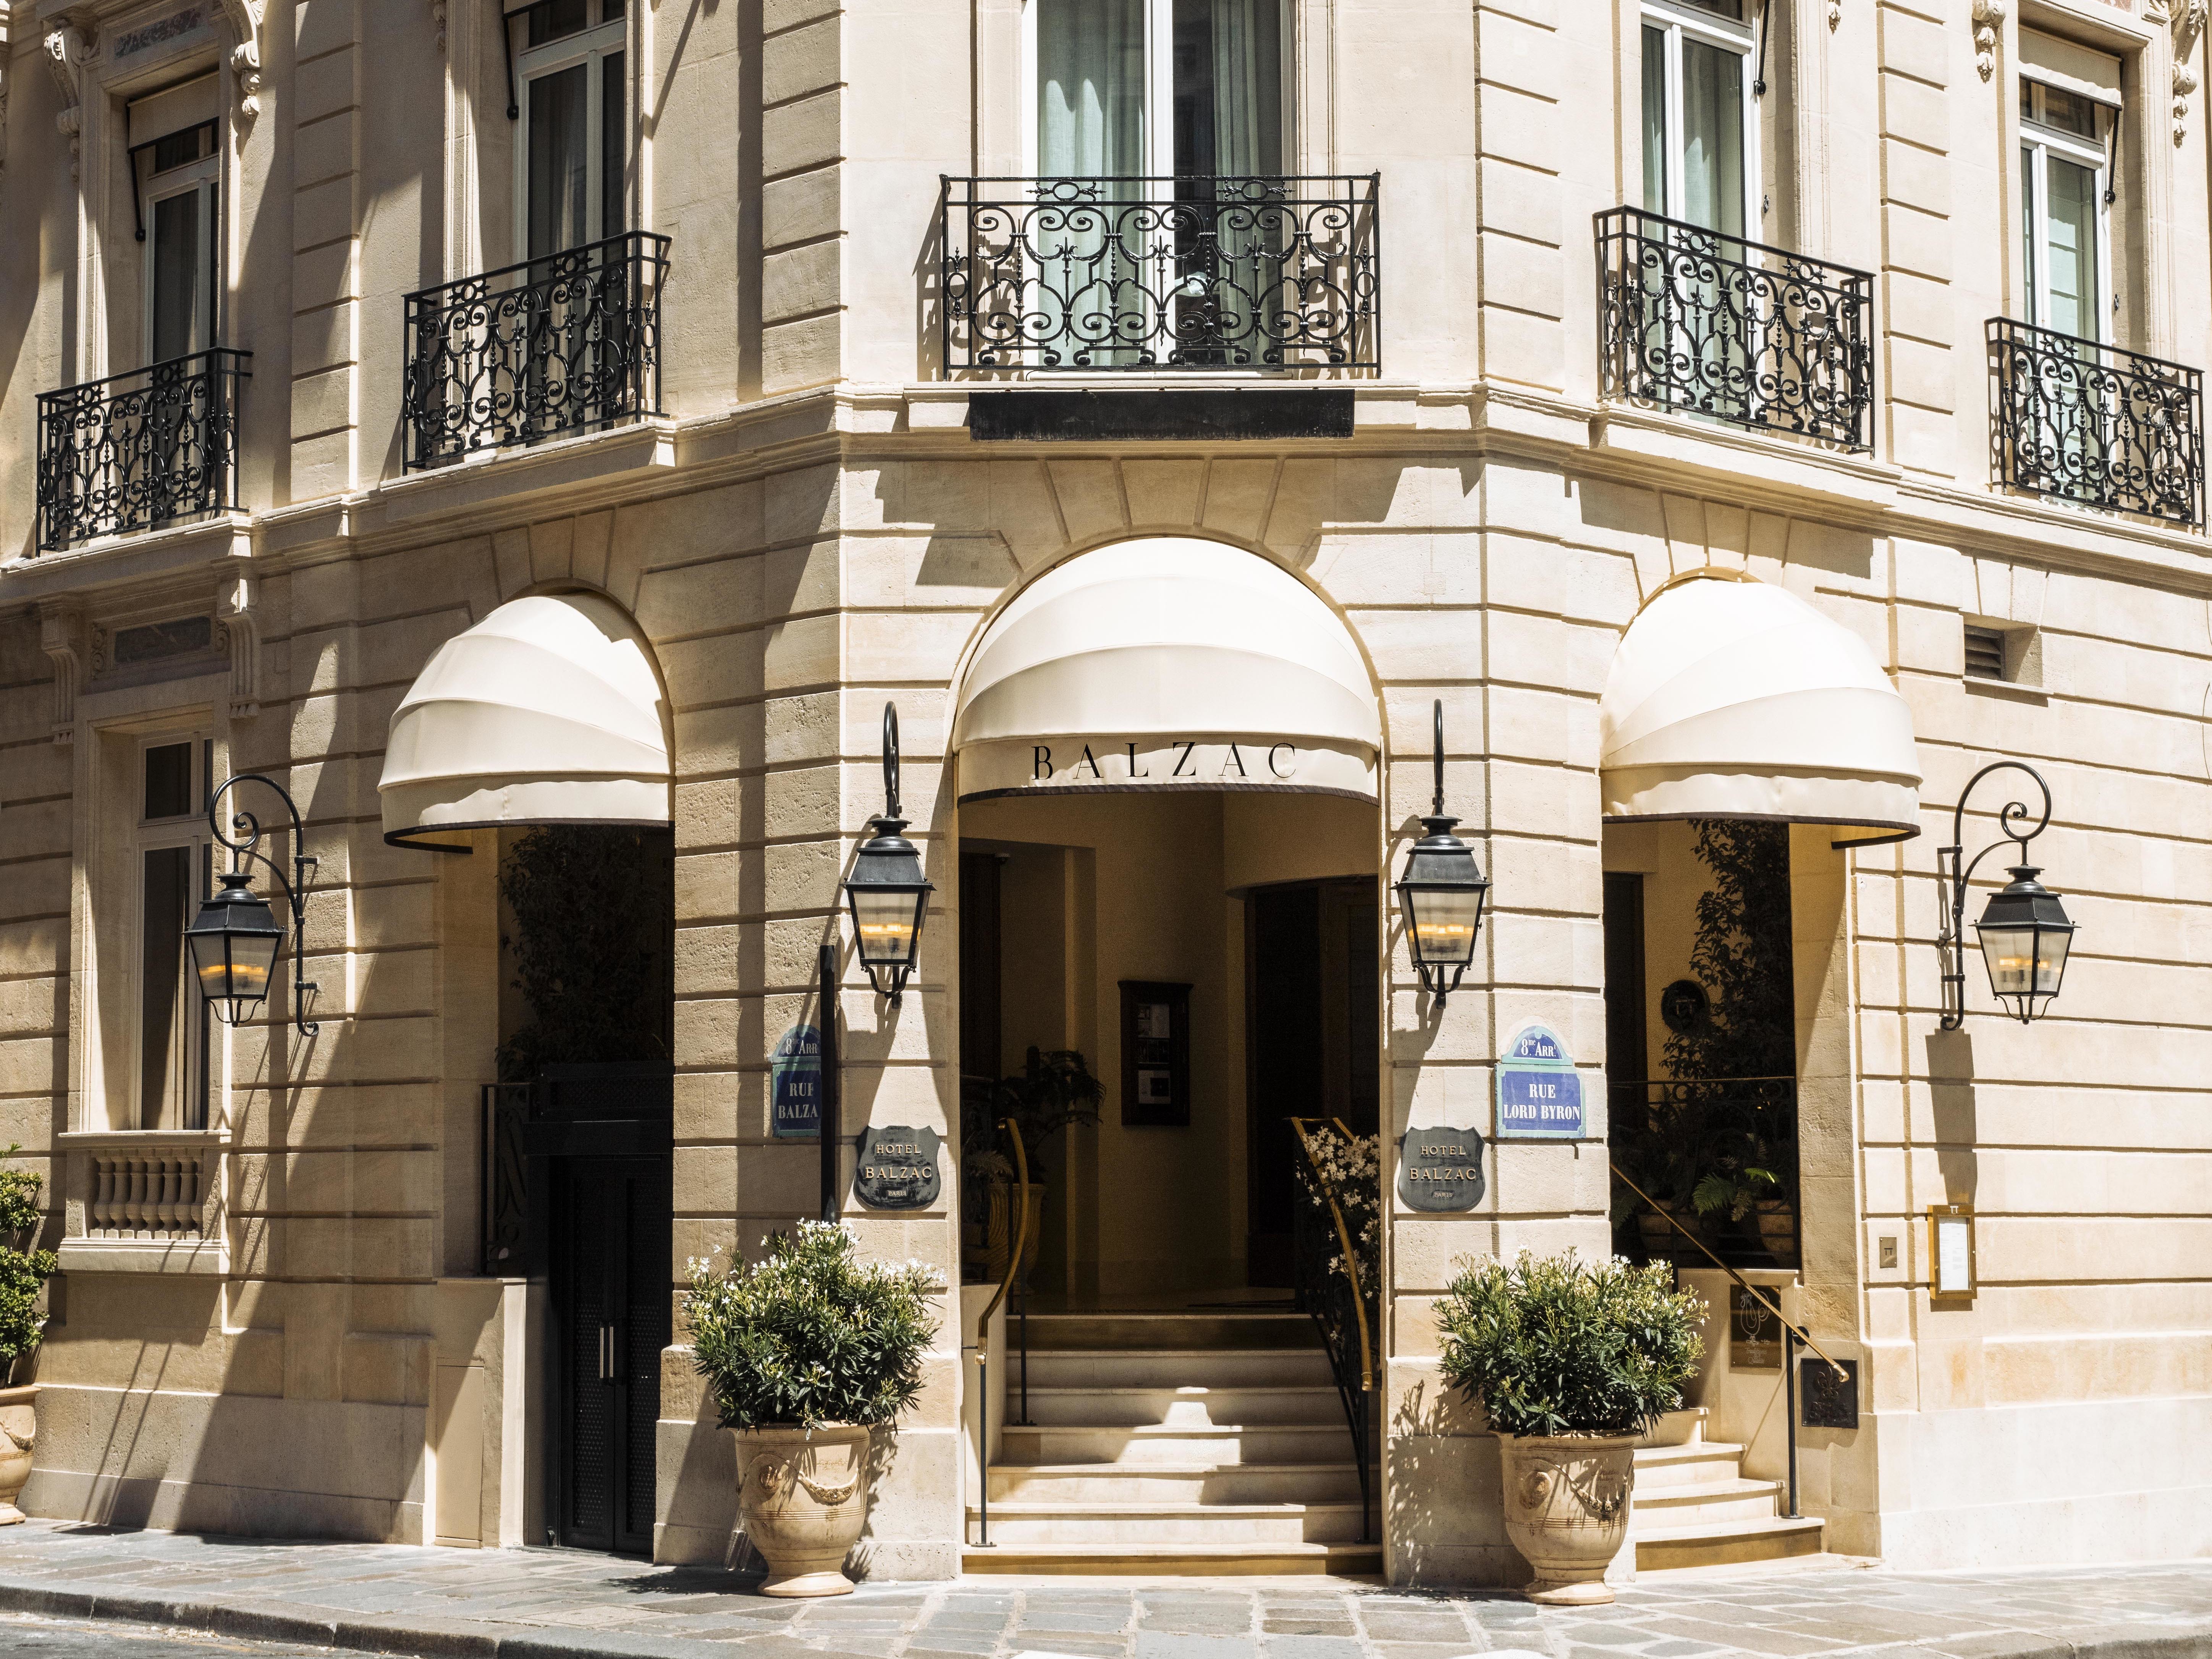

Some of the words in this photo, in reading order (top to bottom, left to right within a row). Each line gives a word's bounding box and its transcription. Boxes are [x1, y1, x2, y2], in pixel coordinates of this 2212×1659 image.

[1031, 741, 1296, 781] BALZAC
[1529, 1083, 1556, 1098] RUE
[778, 1104, 818, 1119] BALZA
[1503, 1104, 1537, 1119] LORD
[1541, 1105, 1580, 1120] BYRON
[876, 1144, 922, 1155] HOTEL
[1420, 1146, 1467, 1156] HOTEL
[865, 1166, 933, 1180] BALZAC
[1410, 1168, 1477, 1181] BALZAC
